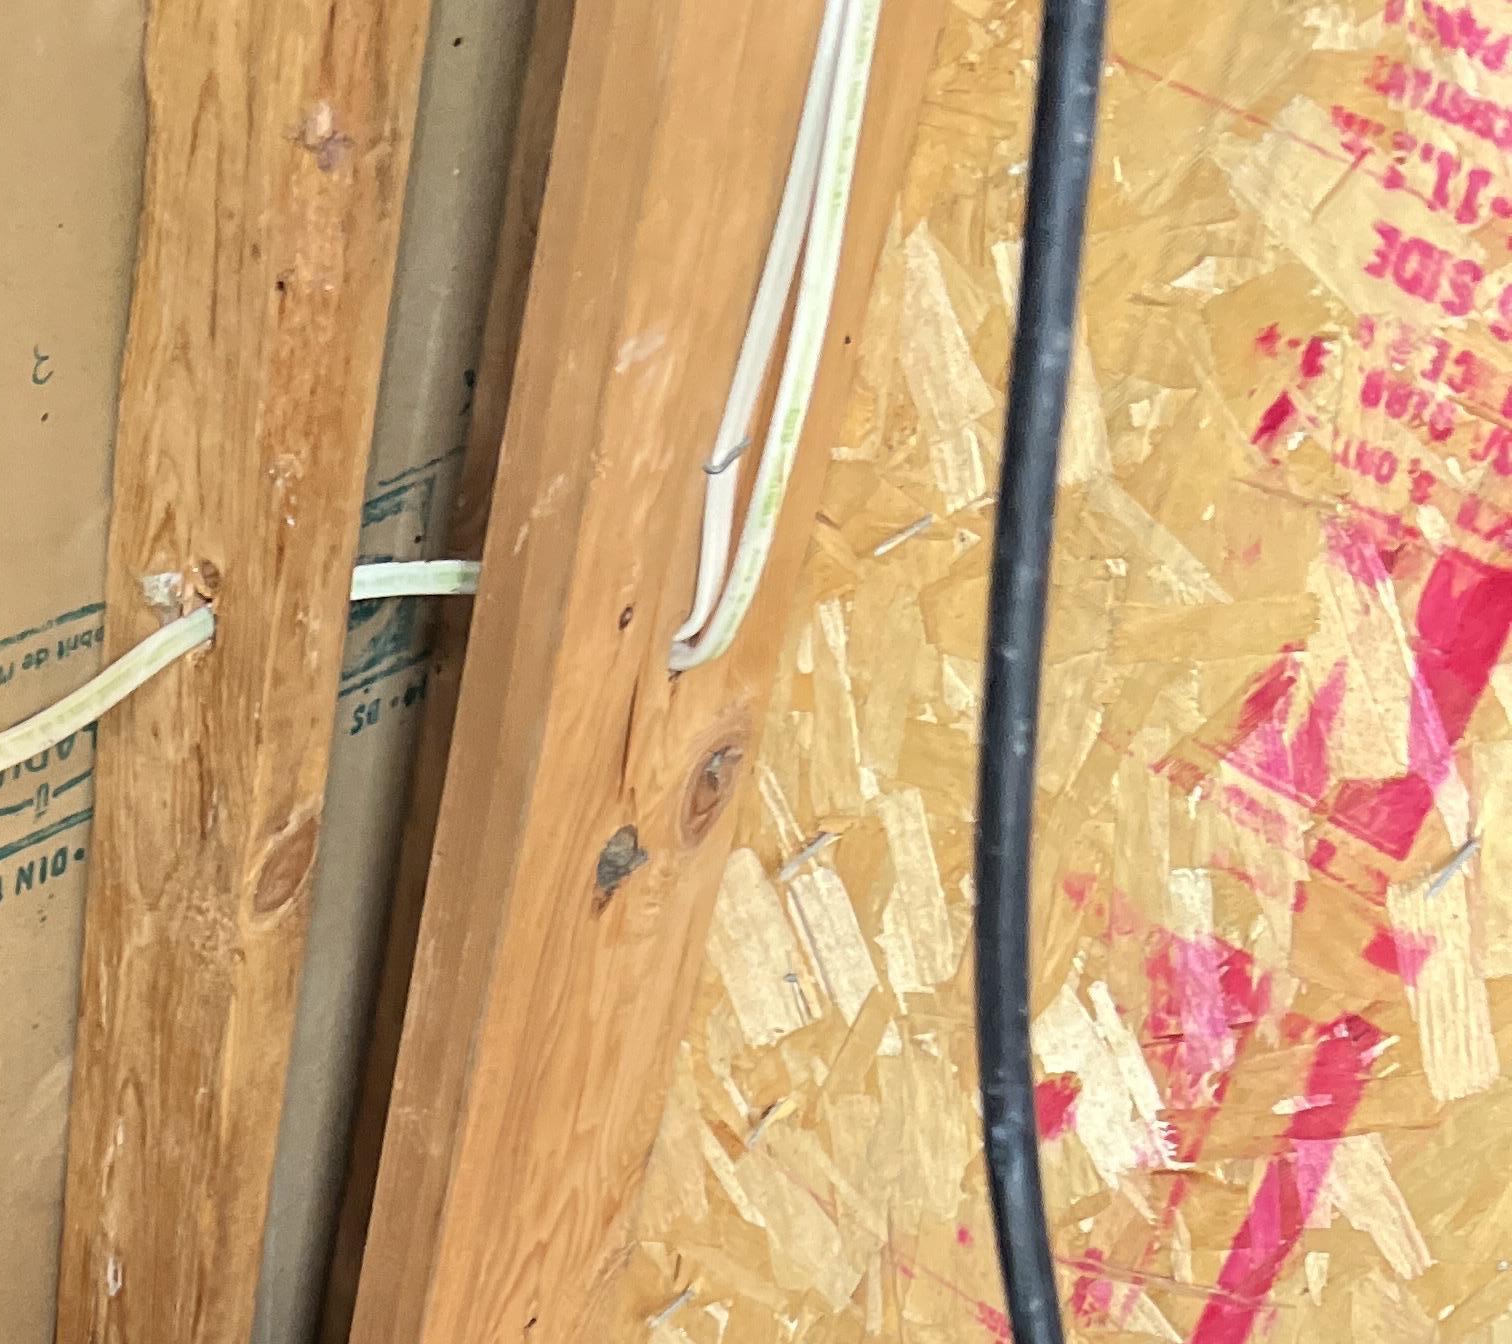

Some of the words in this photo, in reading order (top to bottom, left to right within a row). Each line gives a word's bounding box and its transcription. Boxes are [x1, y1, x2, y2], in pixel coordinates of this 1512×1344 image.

[1363, 220, 1484, 316] SIDE
[21, 647, 50, 671] de
[14, 845, 69, 896] DIN
